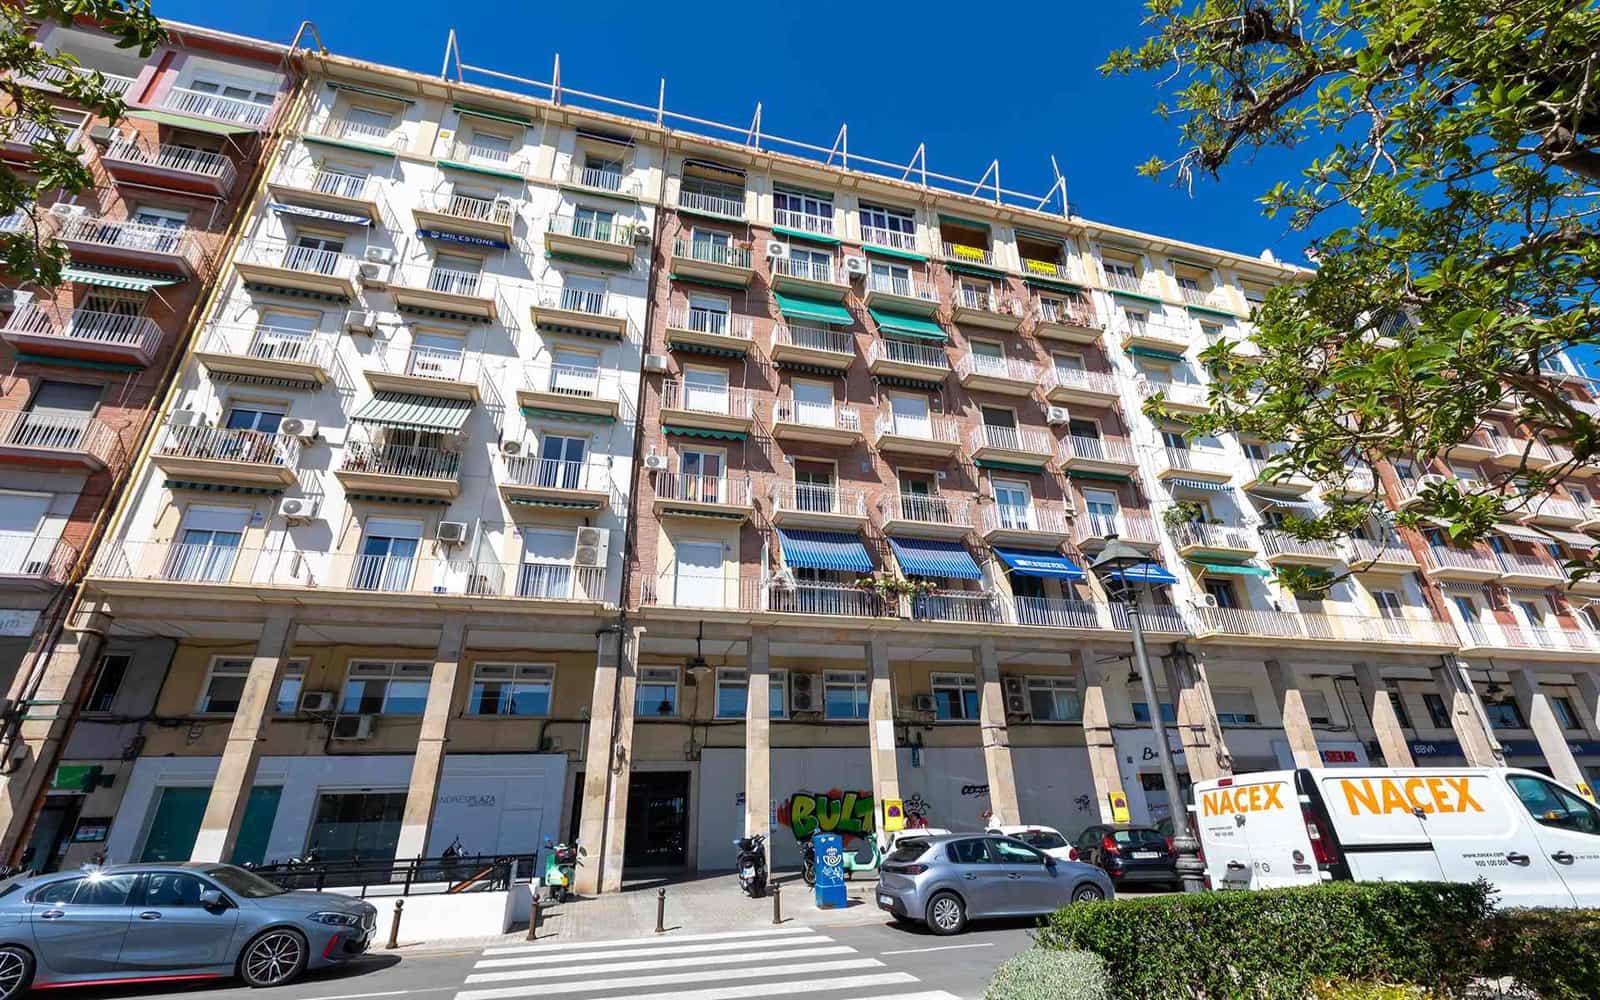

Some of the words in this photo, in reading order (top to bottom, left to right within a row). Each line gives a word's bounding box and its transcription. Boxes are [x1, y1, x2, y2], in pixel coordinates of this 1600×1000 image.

[441, 233, 496, 246] MILESTONE
[1203, 784, 1284, 816] NACEX
[1340, 778, 1485, 816] NACEX
